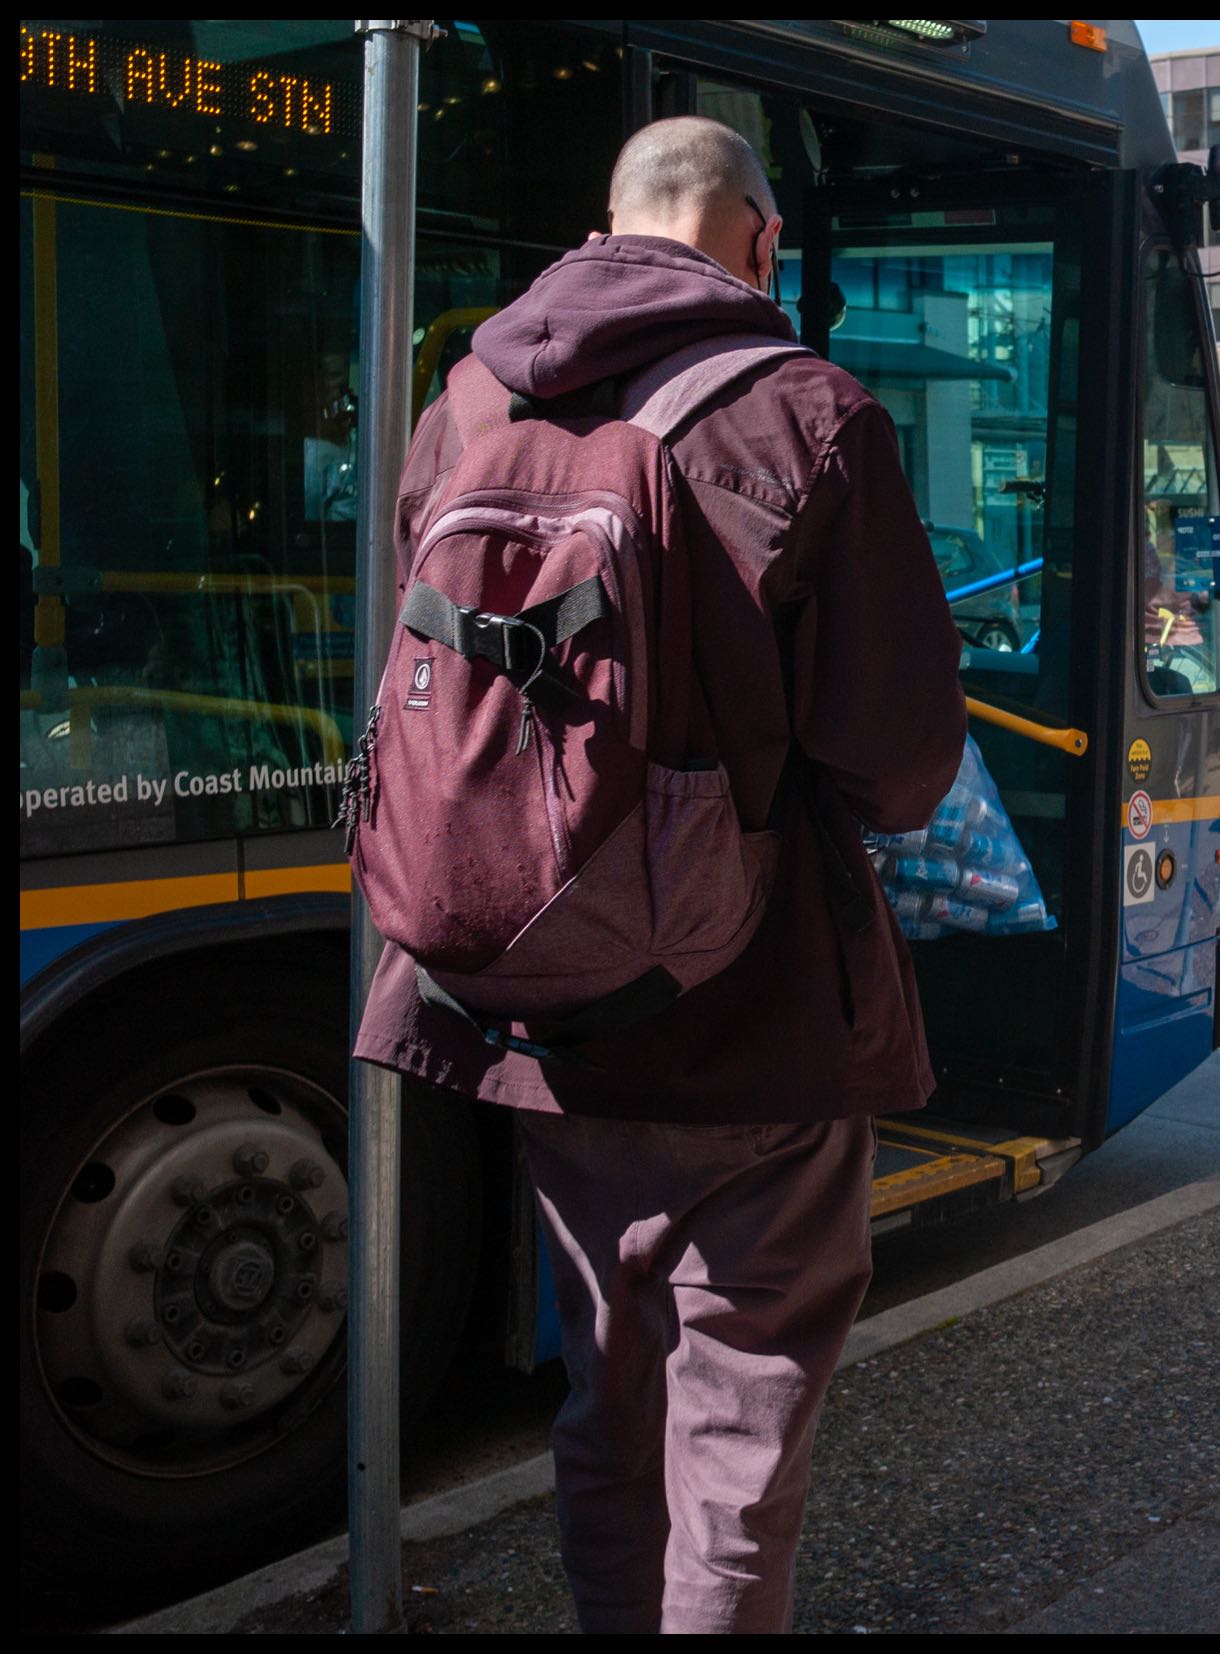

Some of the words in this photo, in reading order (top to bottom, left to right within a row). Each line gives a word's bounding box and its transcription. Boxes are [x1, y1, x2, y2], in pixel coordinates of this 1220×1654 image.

[127, 48, 222, 114] AVE
[250, 71, 331, 134] STN
[20, 776, 128, 818] perated
[137, 775, 166, 806] by
[174, 768, 242, 797] Coast
[250, 757, 346, 791] Mountai
